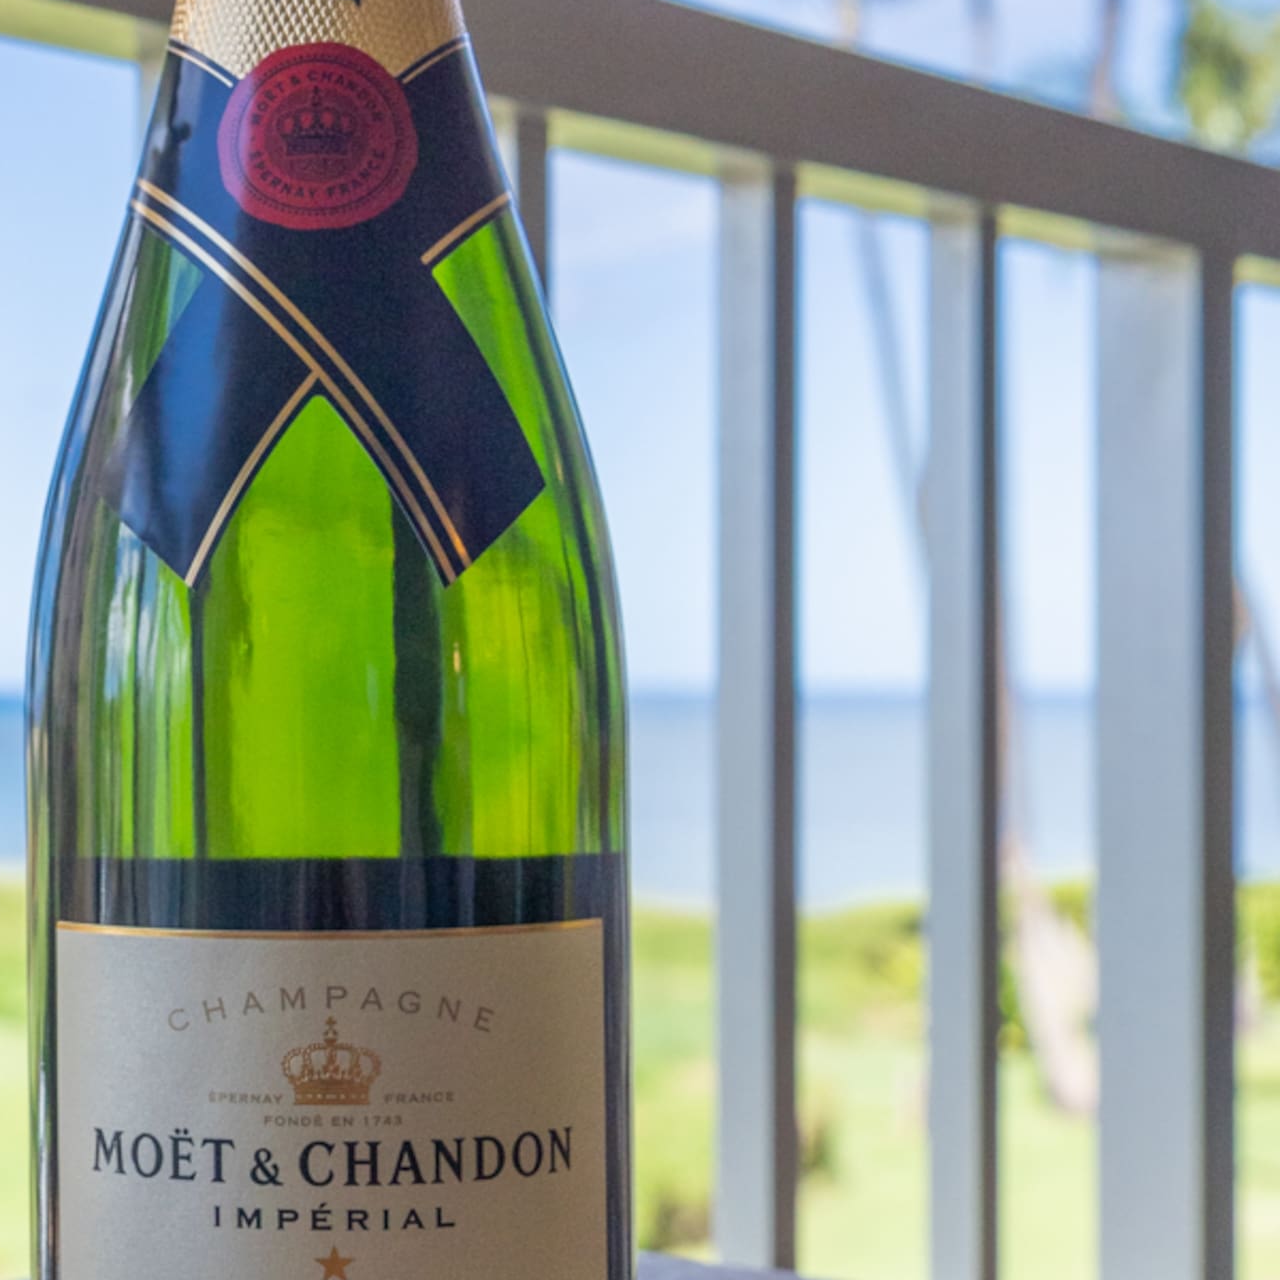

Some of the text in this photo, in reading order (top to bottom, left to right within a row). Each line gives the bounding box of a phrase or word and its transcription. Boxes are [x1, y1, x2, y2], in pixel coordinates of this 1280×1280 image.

[290, 74, 303, 87] &
[326, 149, 386, 199] FRANCE
[167, 985, 496, 1033] CHAMPAGNE
[384, 1090, 456, 1105] FRANCE
[330, 1115, 355, 1128] EN
[363, 1114, 404, 1128] 1743
[92, 1126, 574, 1188] MOËT & CHANDON
[213, 1202, 457, 1232] IMPÉRIAL
